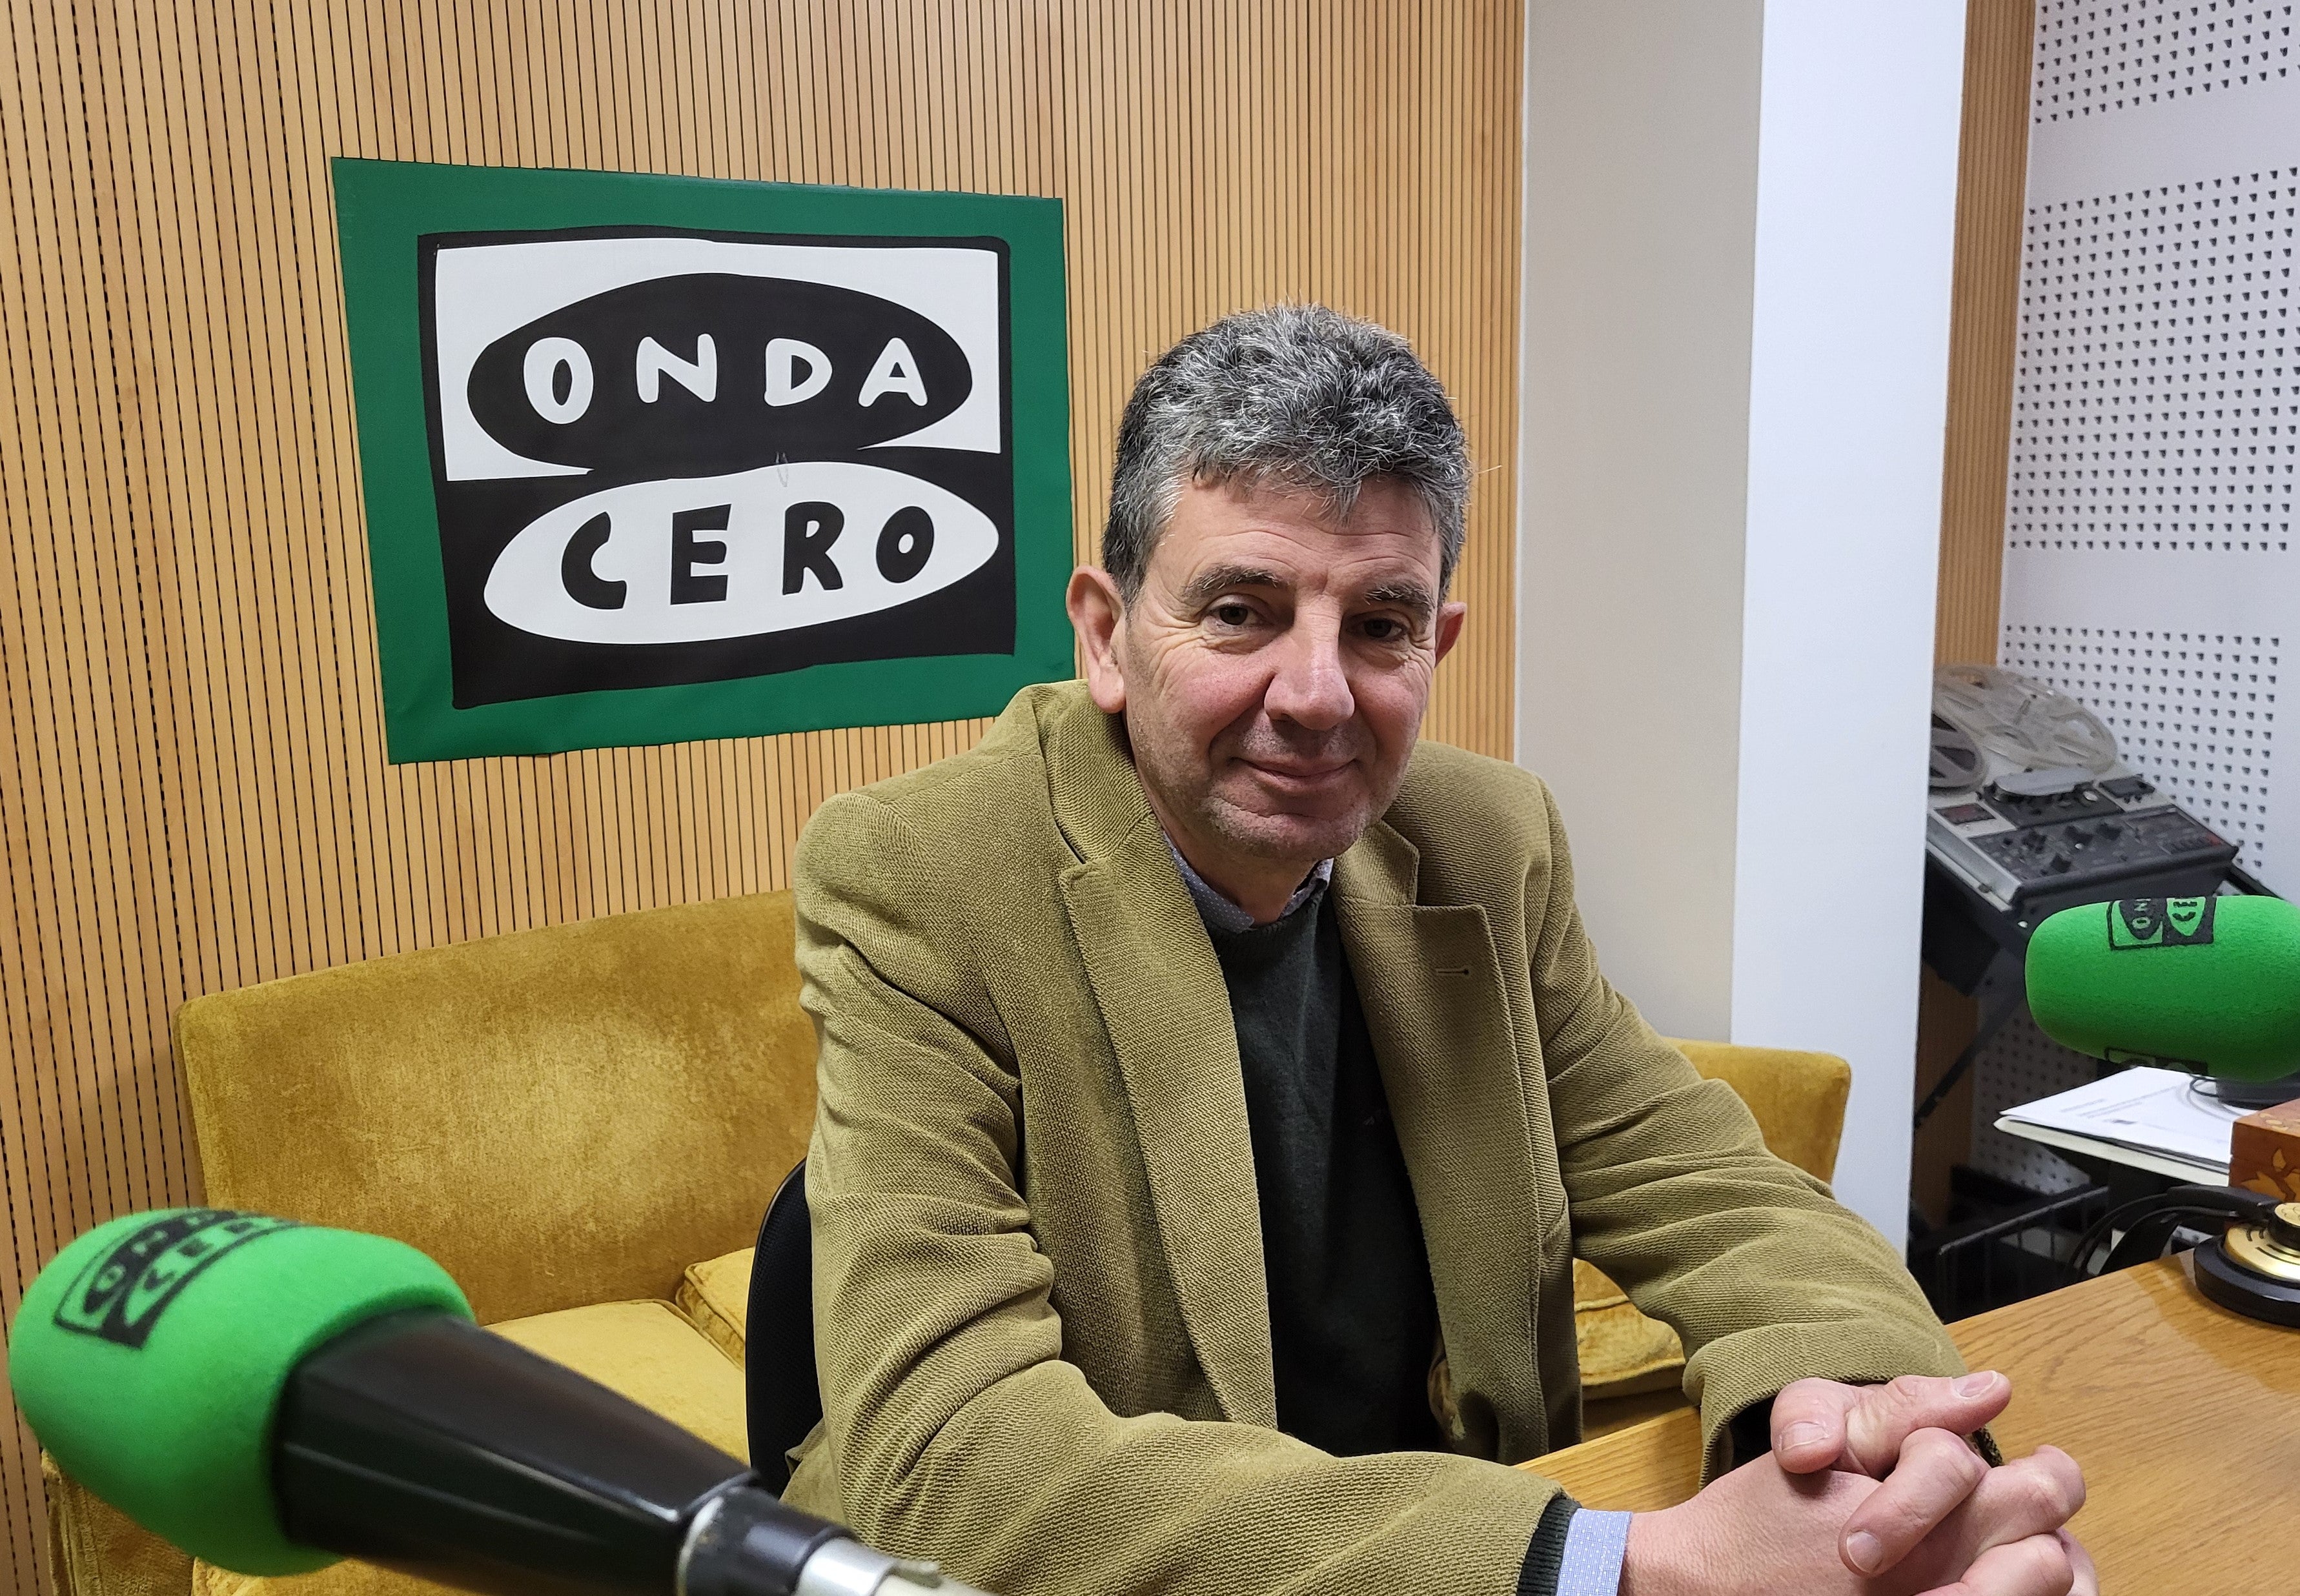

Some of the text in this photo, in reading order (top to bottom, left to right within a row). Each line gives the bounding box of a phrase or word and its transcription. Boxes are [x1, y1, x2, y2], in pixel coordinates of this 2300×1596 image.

[523, 333, 928, 425] ONDA
[561, 501, 935, 610] CERO
[2132, 898, 2152, 929] ON
[2172, 898, 2198, 922] CE
